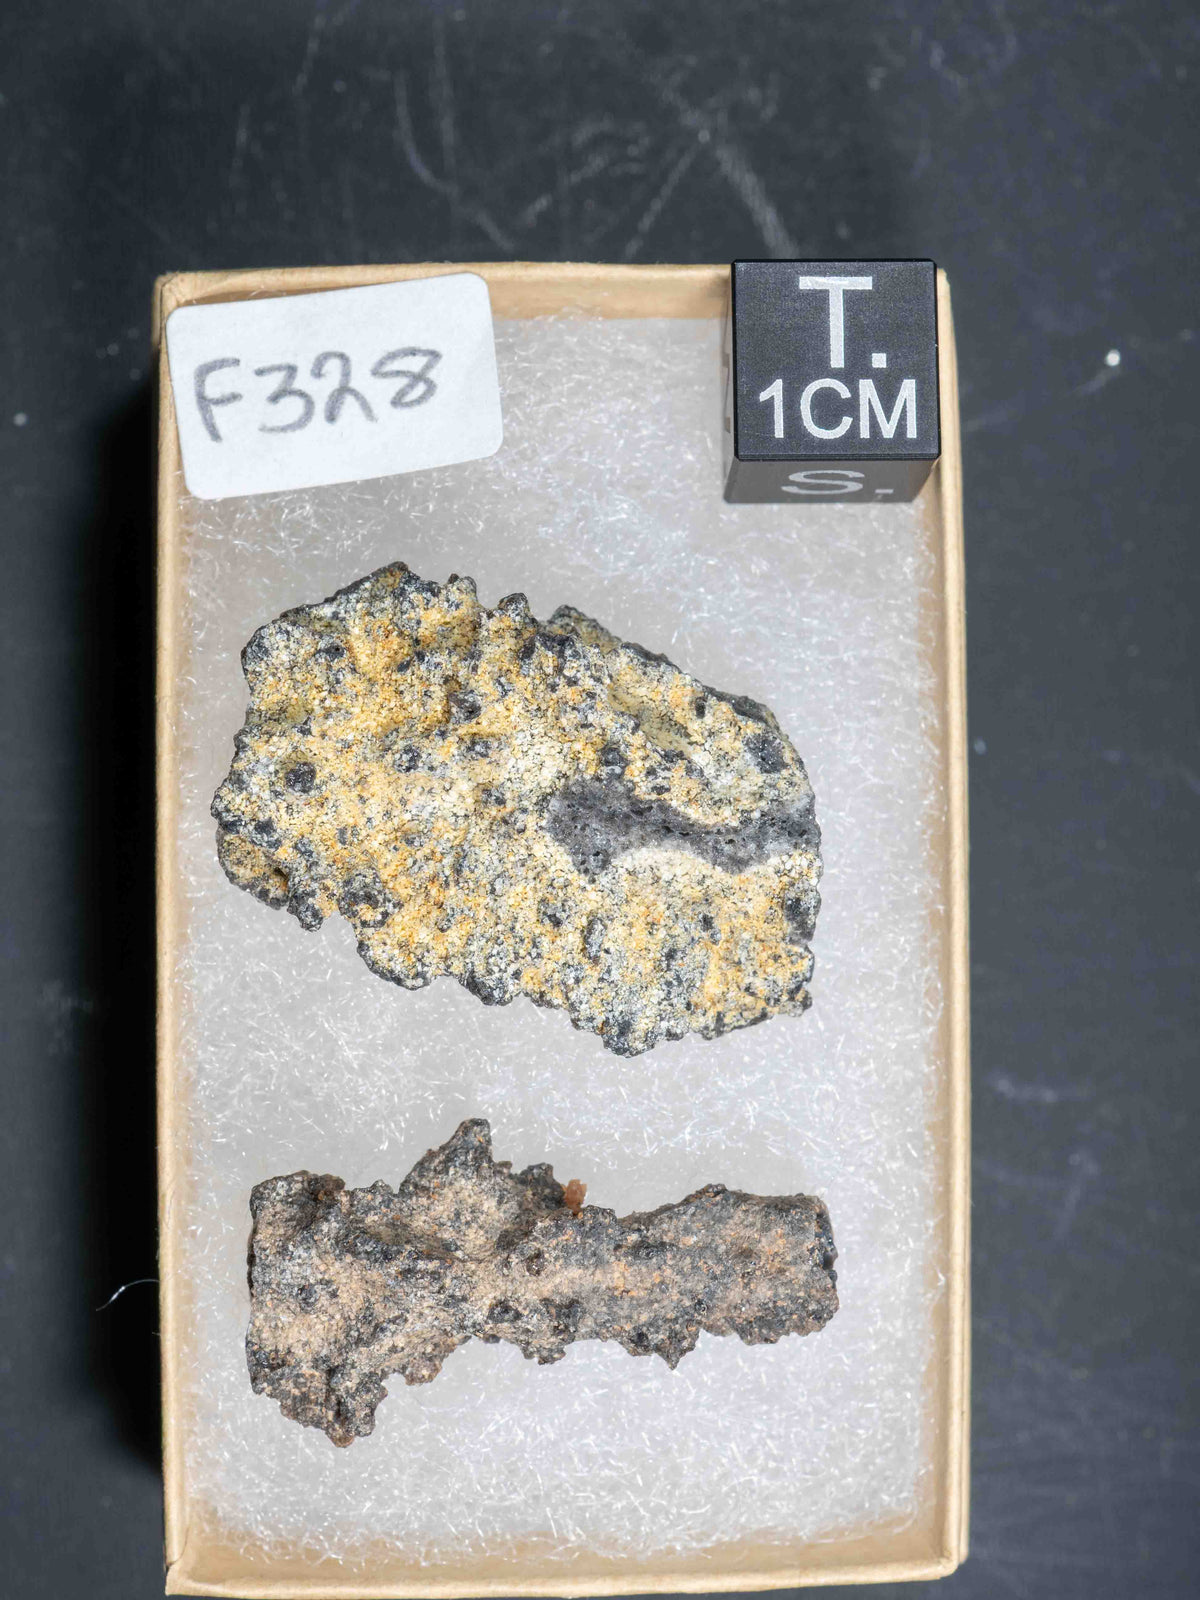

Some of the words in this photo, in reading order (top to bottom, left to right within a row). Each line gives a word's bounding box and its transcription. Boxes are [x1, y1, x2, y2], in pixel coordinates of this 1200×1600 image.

[799, 275, 888, 368] T.
[193, 346, 443, 442] F328
[758, 377, 918, 440] 1CM
